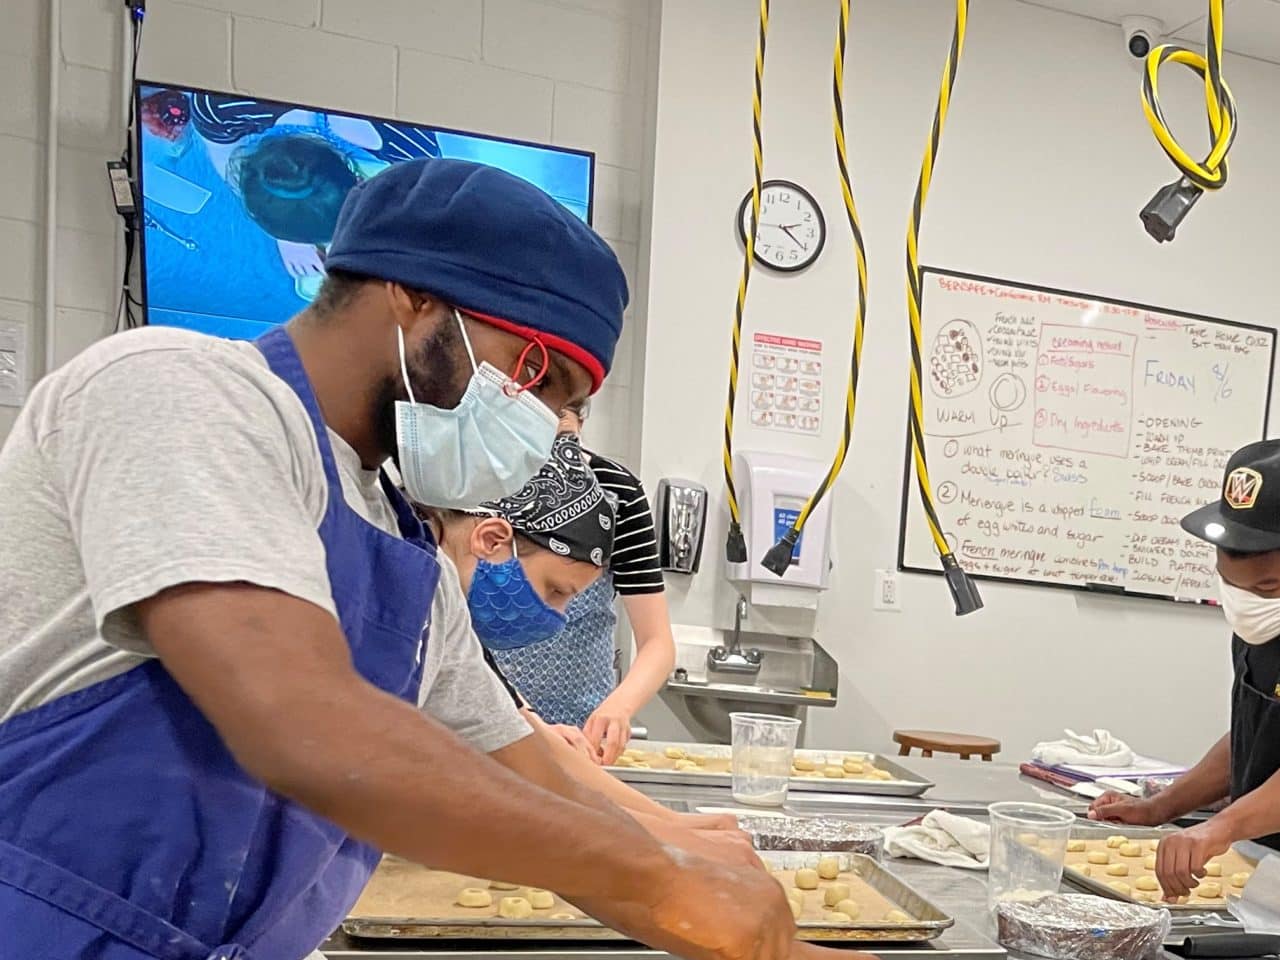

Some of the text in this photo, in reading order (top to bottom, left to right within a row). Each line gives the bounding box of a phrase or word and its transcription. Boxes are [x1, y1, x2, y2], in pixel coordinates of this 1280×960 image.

[767, 194, 774, 204] 11
[779, 192, 790, 203] 12
[803, 212, 811, 222] 2
[763, 244, 771, 254] 7
[776, 250, 784, 261] 6
[790, 250, 798, 260] 5
[977, 520, 1000, 537] egg
